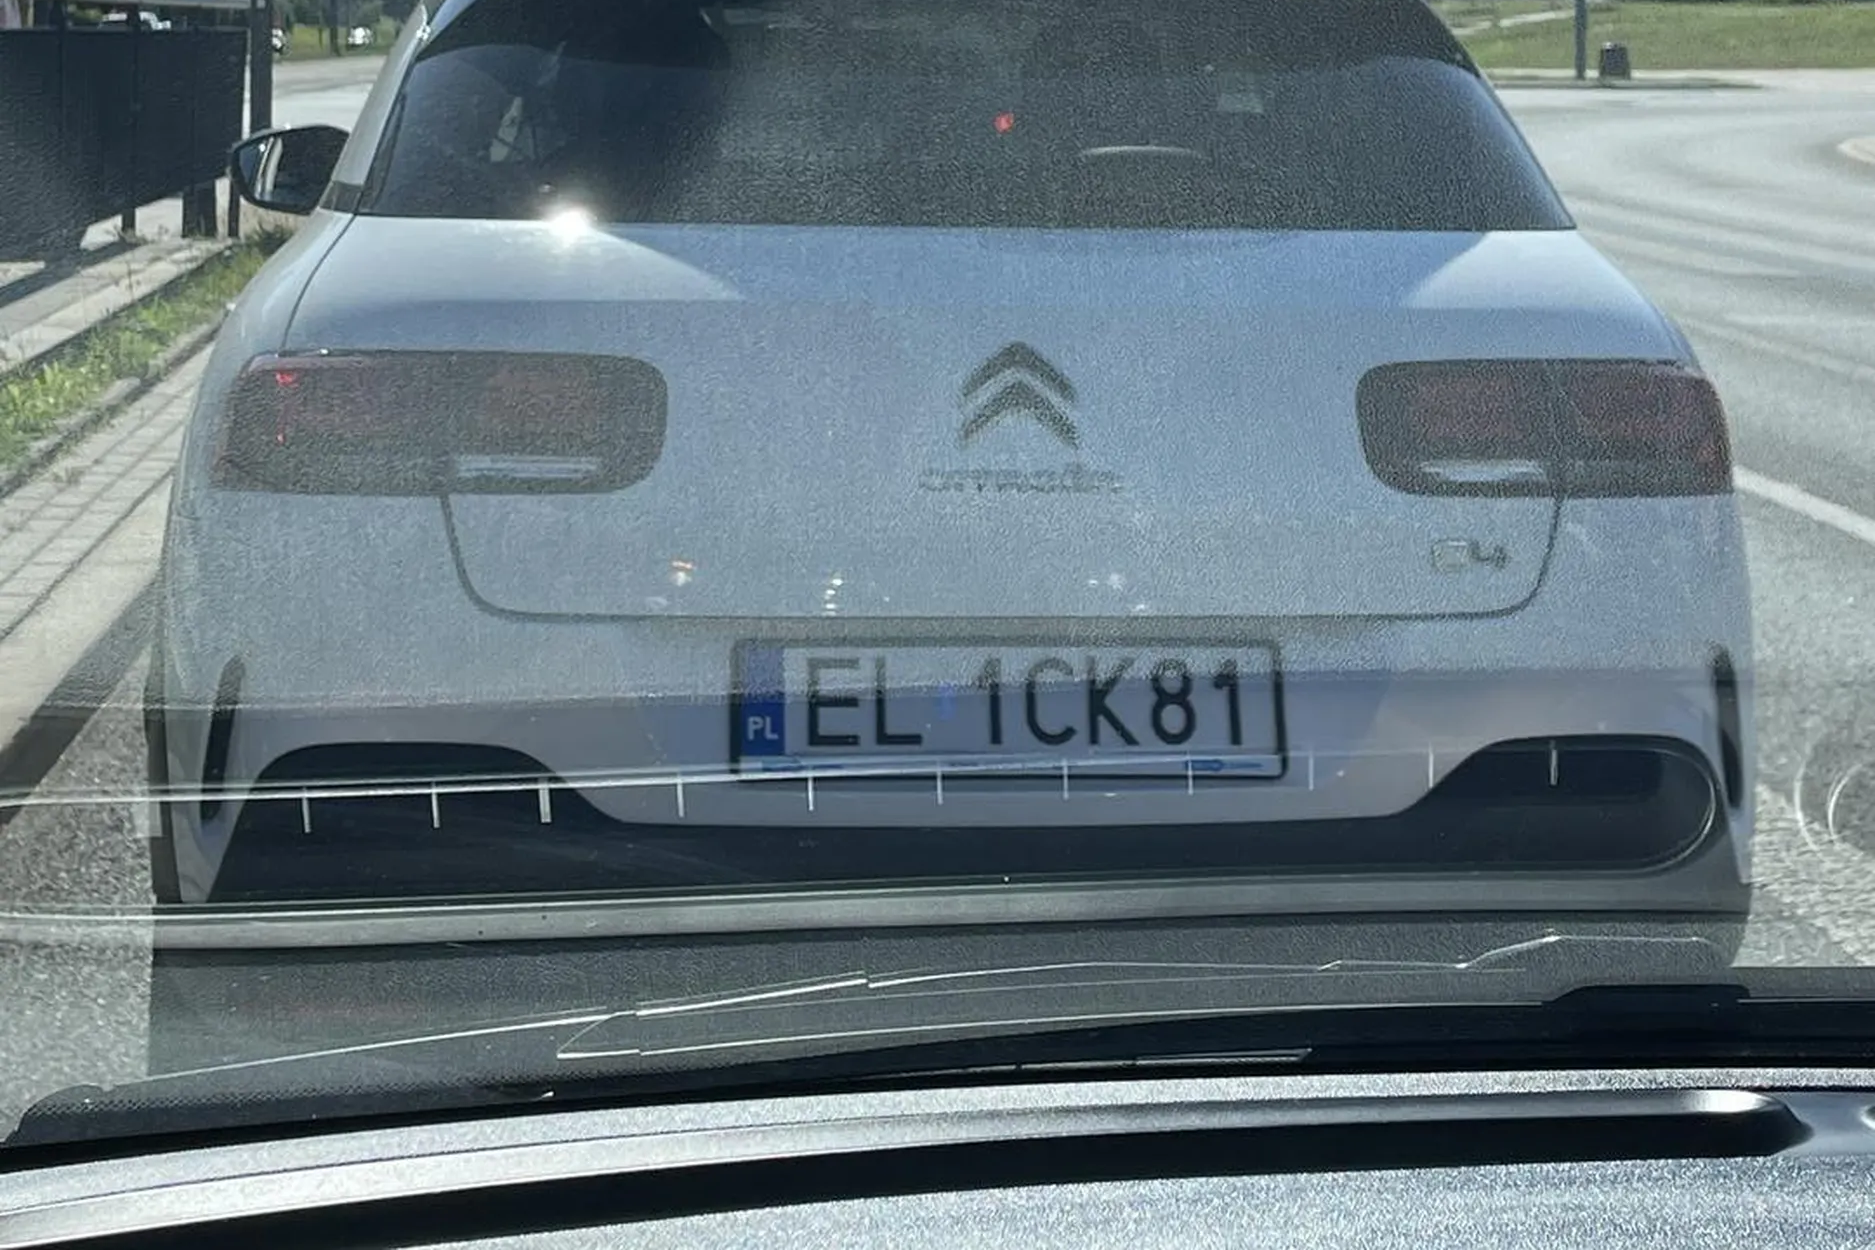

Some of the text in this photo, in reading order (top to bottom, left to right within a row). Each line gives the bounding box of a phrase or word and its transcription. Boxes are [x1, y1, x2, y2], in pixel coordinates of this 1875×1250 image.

[747, 715, 779, 741] PL
[806, 657, 1242, 747] EL 1CK81
